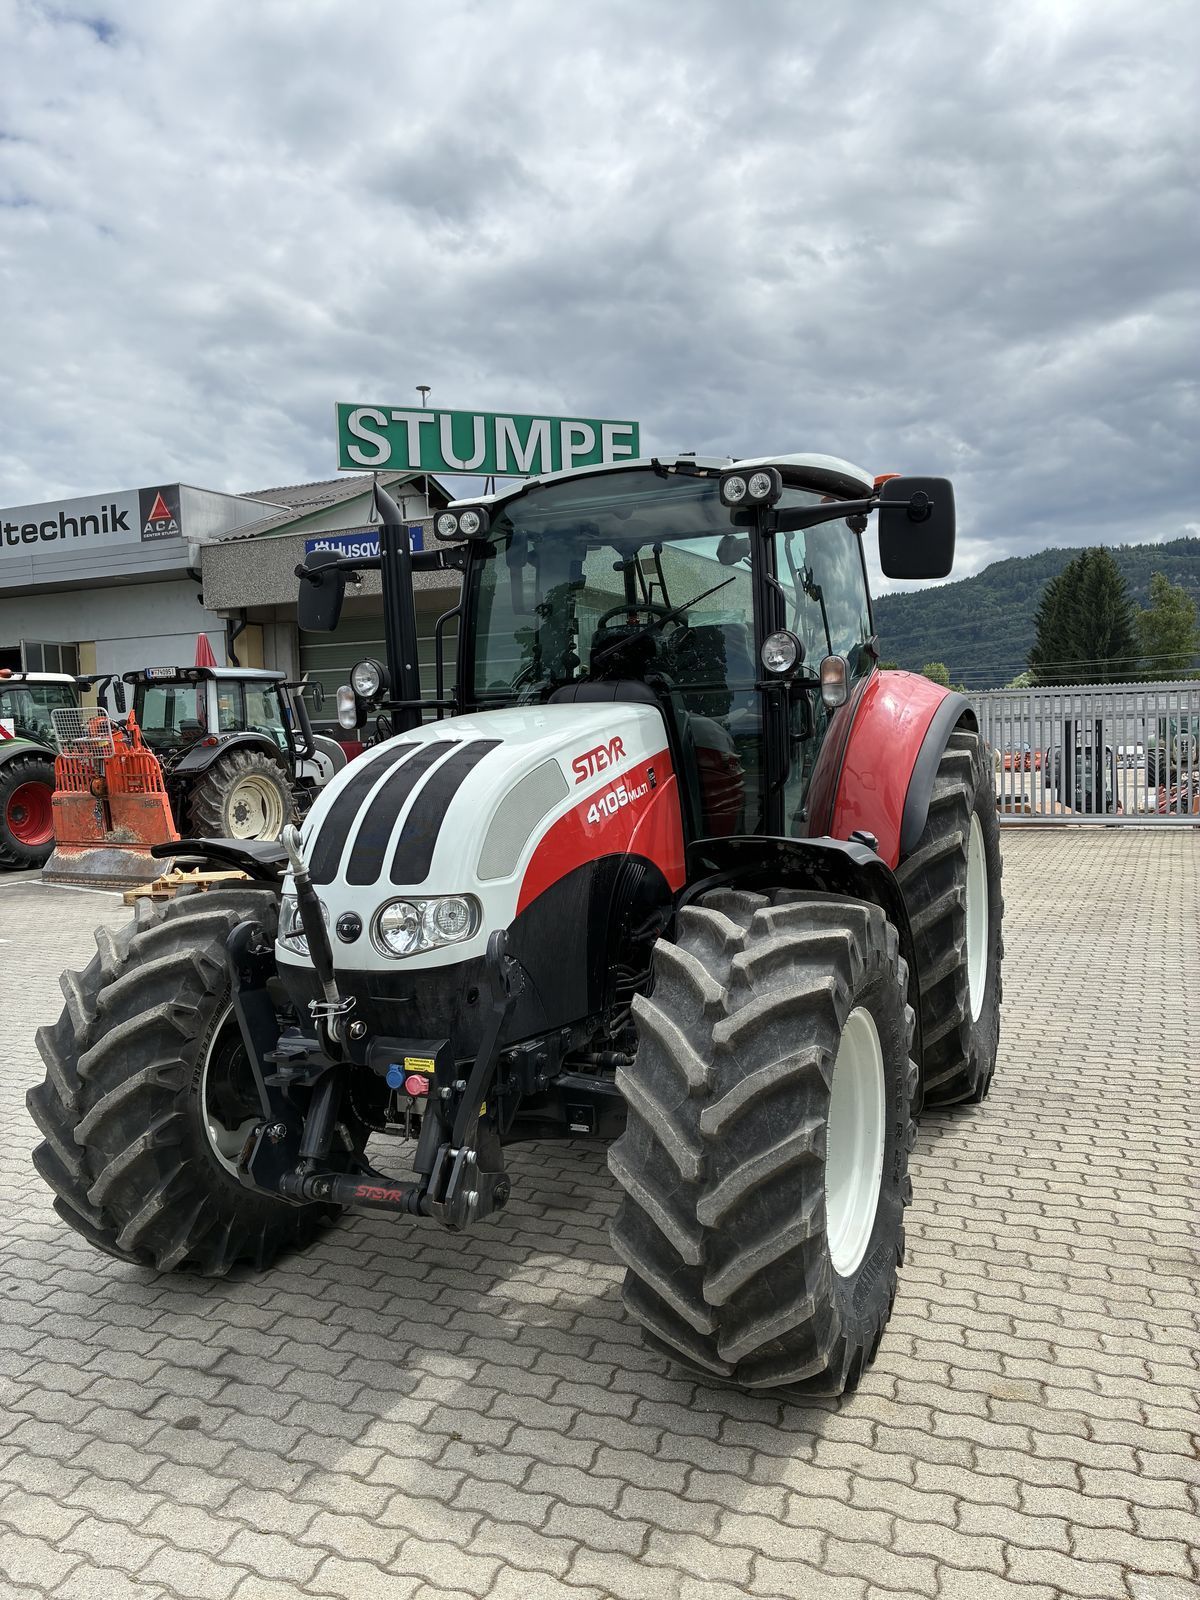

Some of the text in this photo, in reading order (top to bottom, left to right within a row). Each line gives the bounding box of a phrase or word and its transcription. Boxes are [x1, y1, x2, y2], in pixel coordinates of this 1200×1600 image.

[347, 408, 633, 473] STUMPF
[0, 504, 130, 547] technik
[144, 519, 178, 533] ACA
[331, 537, 414, 558] Husqv
[572, 736, 627, 785] STEYR
[587, 782, 649, 823] 4105 MULTI
[336, 923, 361, 931] STEYR
[352, 1185, 402, 1202] STEYR
